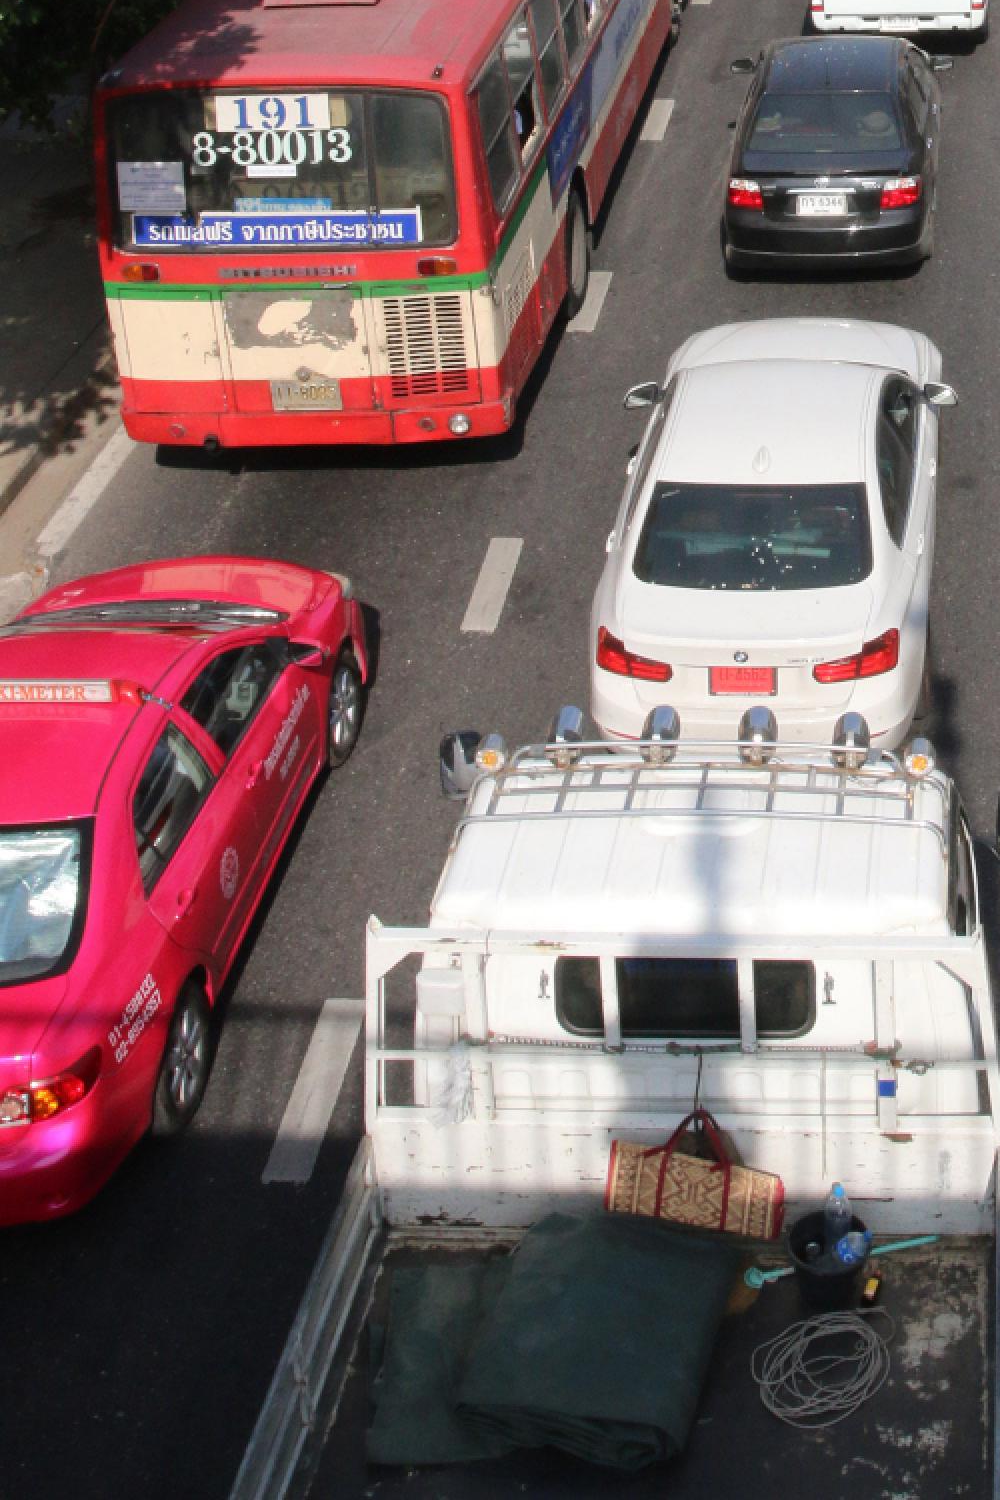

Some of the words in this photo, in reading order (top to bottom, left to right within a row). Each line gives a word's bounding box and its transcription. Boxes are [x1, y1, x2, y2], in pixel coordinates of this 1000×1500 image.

[233, 96, 315, 129] 191
[192, 128, 352, 166] 8-80013
[242, 217, 405, 241] จากภาษีประชาชน
[219, 264, 357, 278] MITSUBISHI
